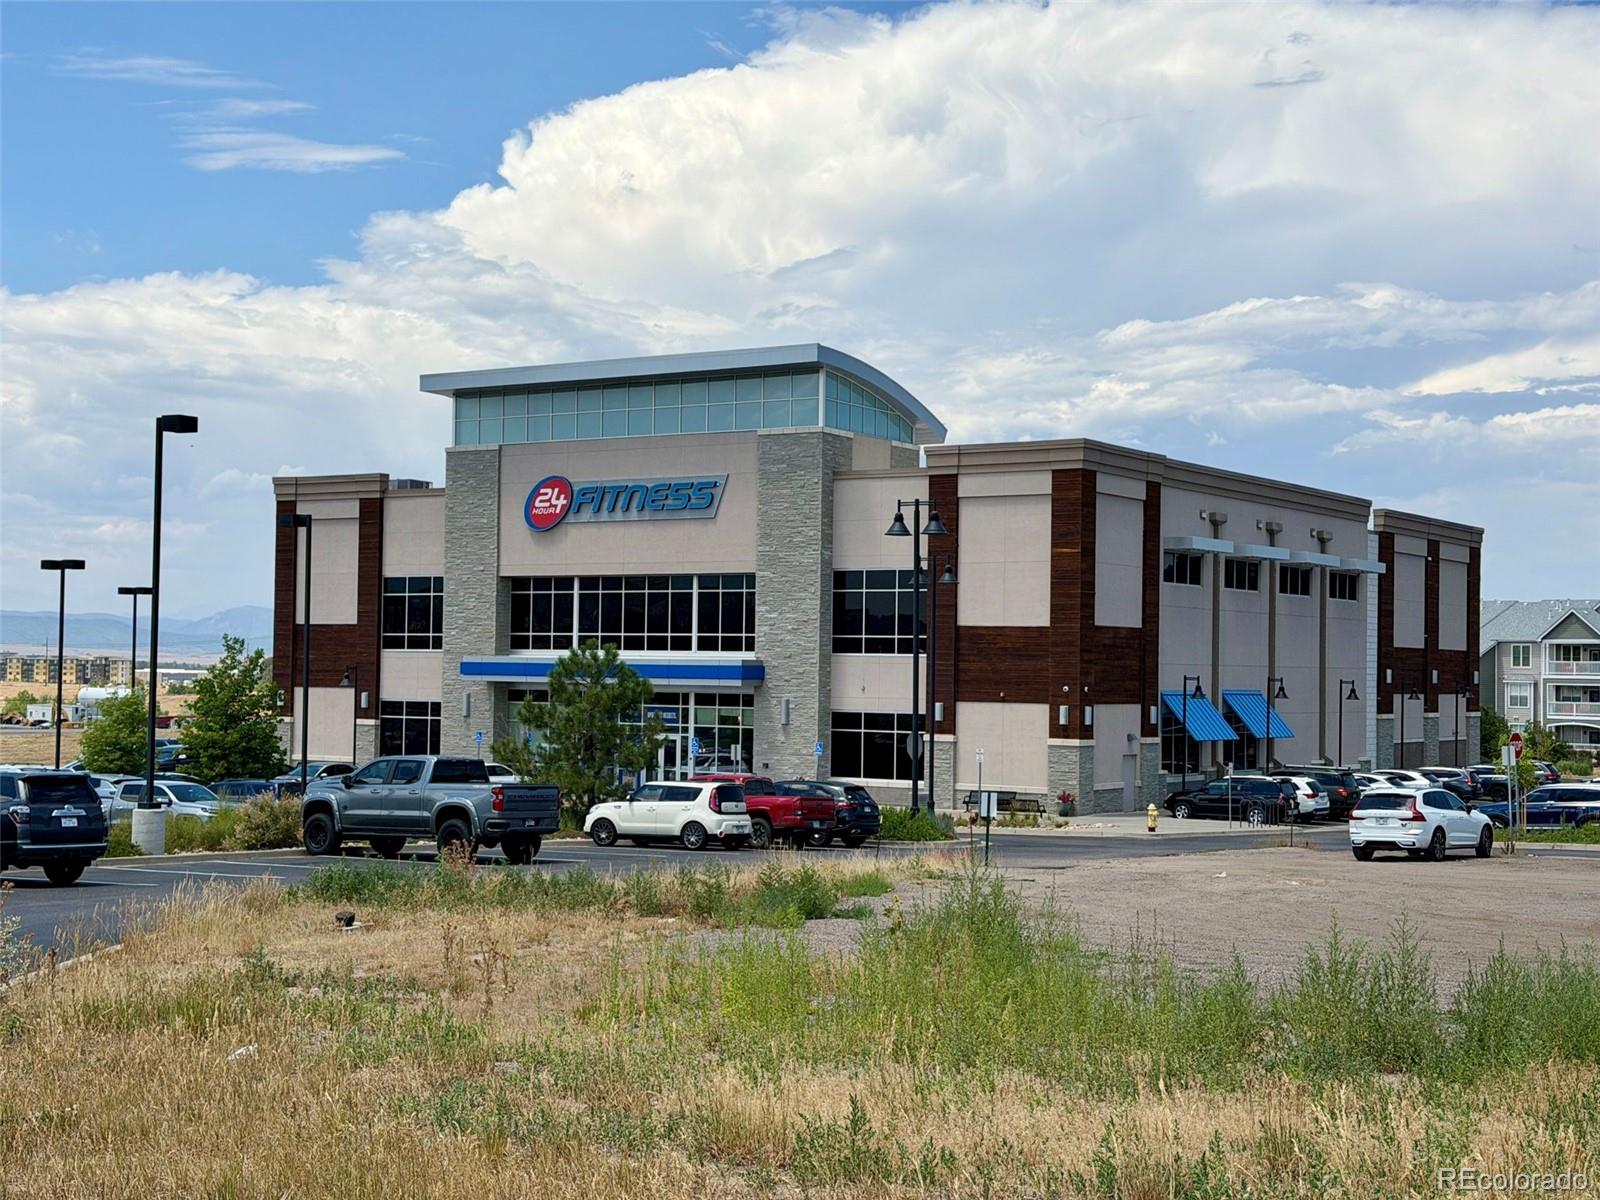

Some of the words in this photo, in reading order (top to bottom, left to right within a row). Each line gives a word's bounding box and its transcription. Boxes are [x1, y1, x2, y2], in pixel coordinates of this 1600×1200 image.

[534, 487, 567, 514] 24
[573, 480, 718, 513] FITNESS
[531, 507, 555, 515] HOUR
